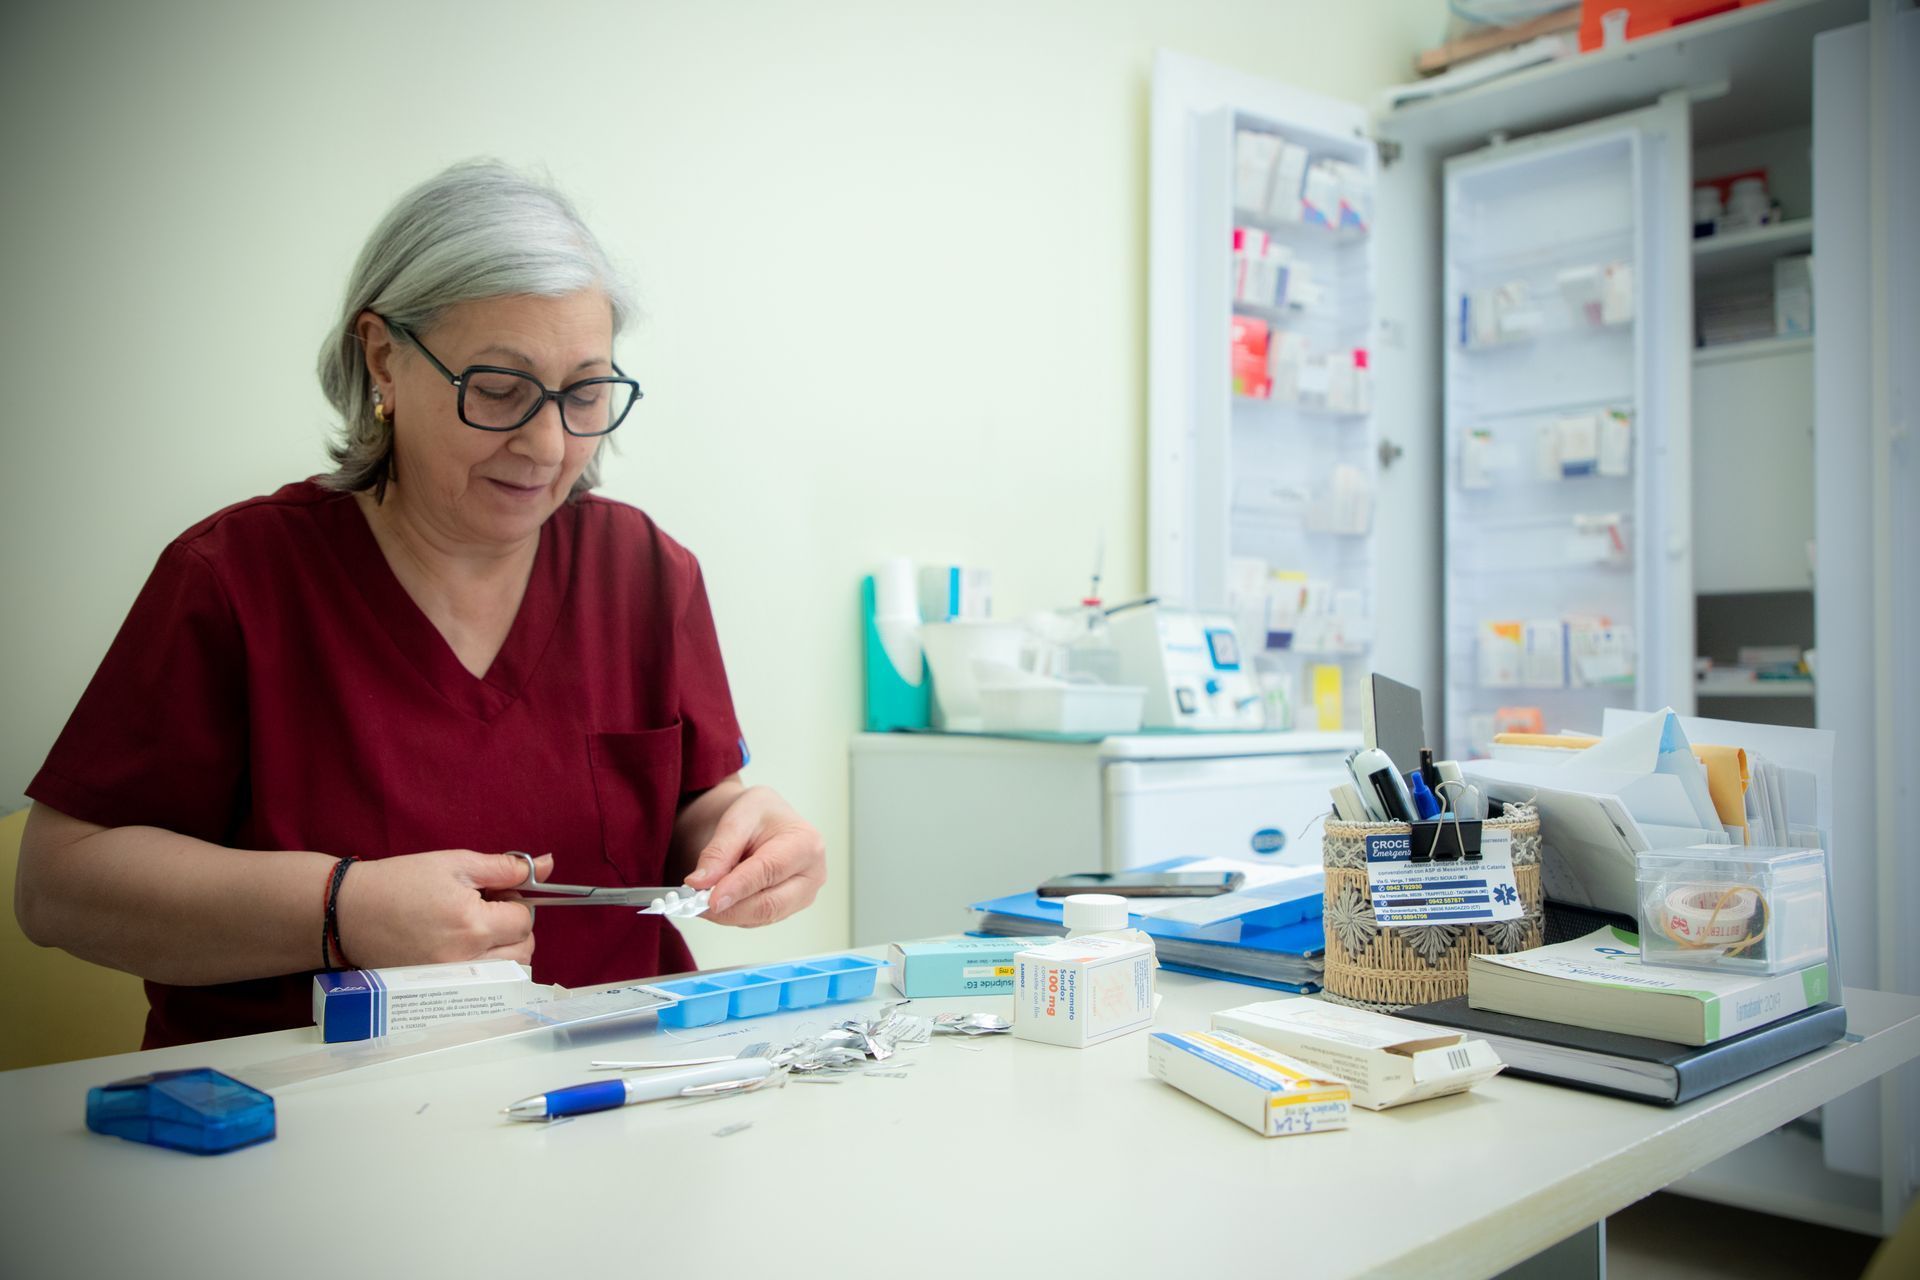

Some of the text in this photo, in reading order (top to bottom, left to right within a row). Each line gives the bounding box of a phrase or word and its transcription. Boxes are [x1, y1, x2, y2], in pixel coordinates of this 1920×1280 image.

[1372, 840, 1410, 849] CROCE
[1695, 924, 1741, 937] BUTTERLY
[979, 979, 1014, 989] isulpride
[1046, 969, 1059, 1018] 100 mg
[1059, 968, 1068, 1002] Sandoz
[1067, 969, 1077, 1021] Topiramato
